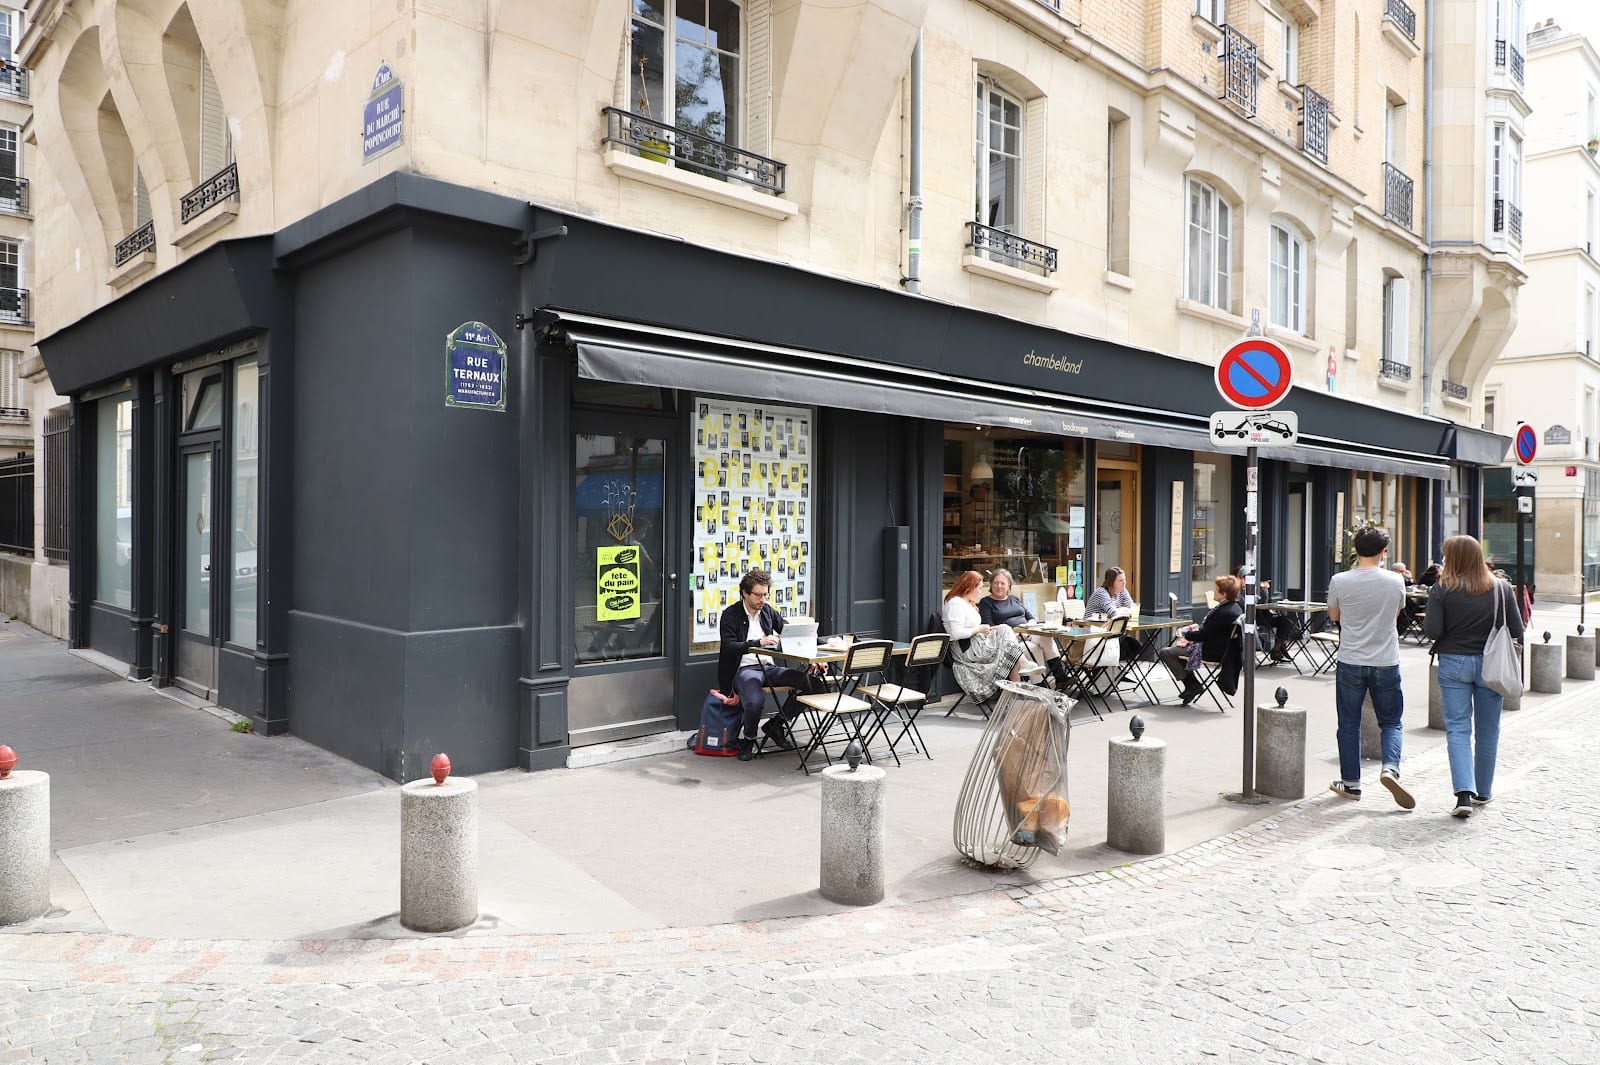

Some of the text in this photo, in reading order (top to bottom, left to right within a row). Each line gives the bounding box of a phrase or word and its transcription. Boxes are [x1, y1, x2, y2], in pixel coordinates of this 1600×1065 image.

[366, 104, 400, 136] DU MARCHÉ
[376, 98, 390, 115] RUE
[364, 120, 402, 152] POPINCOURT
[453, 368, 500, 383] TERNAUX
[467, 356, 488, 368] RUE
[1023, 350, 1084, 374] chambelland
[703, 415, 797, 451] MERCI
[1062, 421, 1089, 435] boulanger
[703, 457, 804, 490] BRAVO
[702, 500, 798, 531] MERCI
[703, 541, 803, 573] BRAVO
[617, 579, 634, 587] pain
